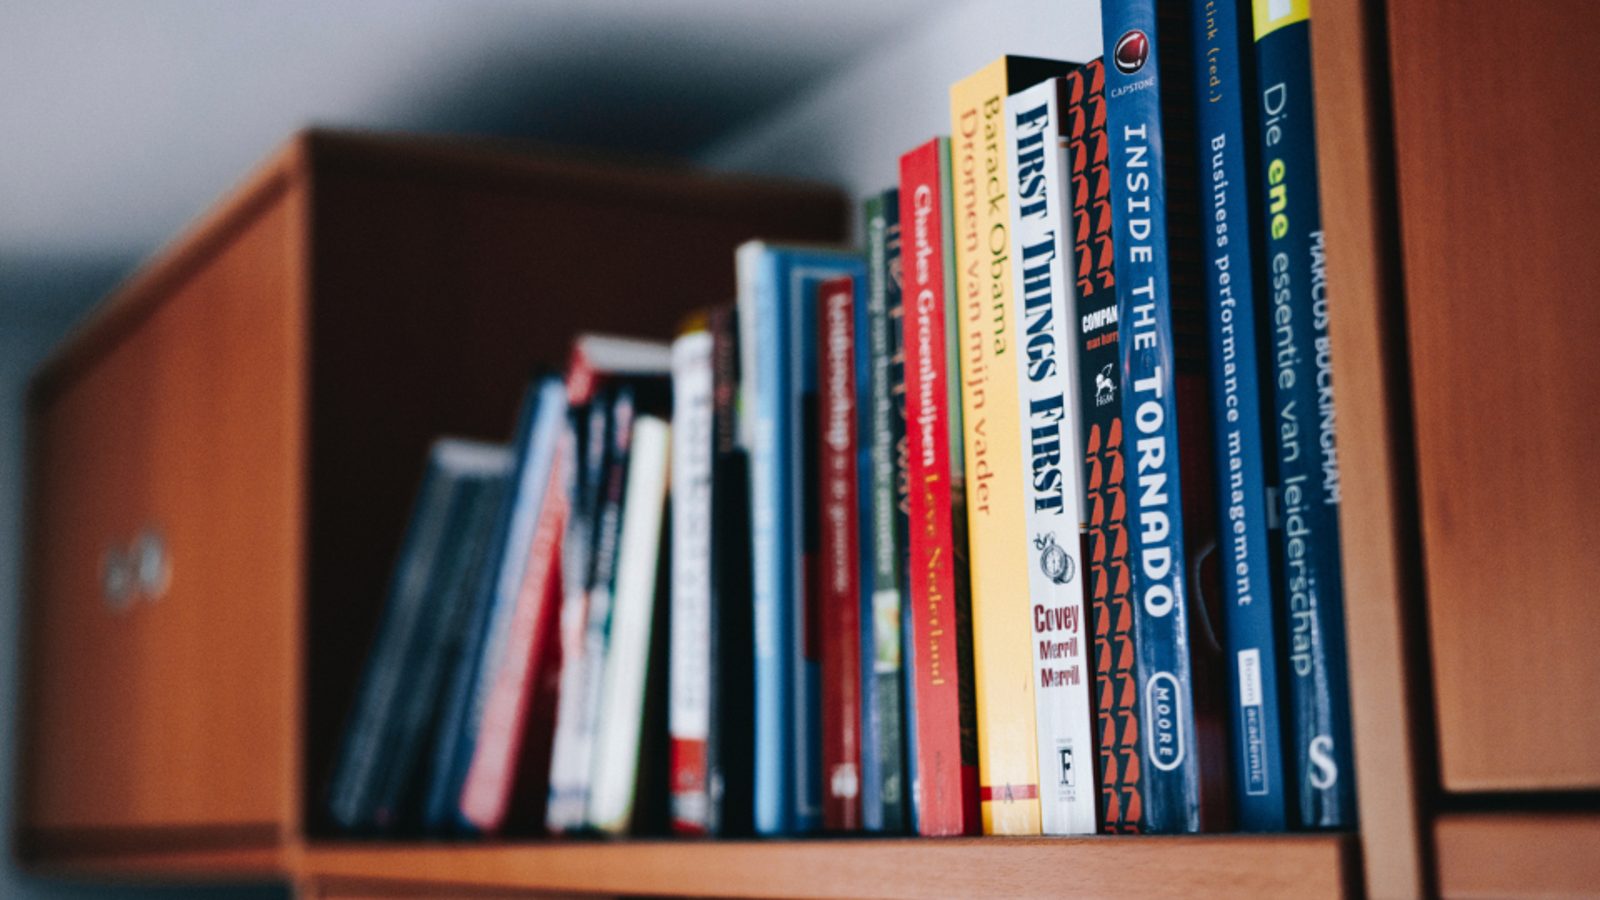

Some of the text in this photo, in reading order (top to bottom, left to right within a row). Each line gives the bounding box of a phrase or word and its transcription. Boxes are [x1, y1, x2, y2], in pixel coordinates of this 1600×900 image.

[1110, 76, 1155, 98] CAPSTONE
[1206, 47, 1223, 103] (red.)
[983, 95, 1008, 356] Barack Obama
[960, 109, 994, 515] Dromen van mijn vader
[1015, 100, 1065, 515] FIRST THINGS FIRST
[1124, 123, 1174, 618] INSIDE THE TORNADO
[1211, 133, 1252, 606] Business performance management
[1263, 82, 1313, 677] Die ene essentie van leiderschap
[1309, 230, 1342, 504] MARCUS BUCKINGHAM
[913, 184, 945, 686] Charles Groenhuijsen Leve Nederland
[1034, 604, 1079, 634] Covey
[1039, 636, 1079, 661] Merrill
[1041, 664, 1081, 688] Merrill
[1156, 687, 1173, 757] MOORE
[1246, 708, 1263, 784] academic
[1059, 748, 1073, 785] F
[1309, 734, 1338, 790] S
